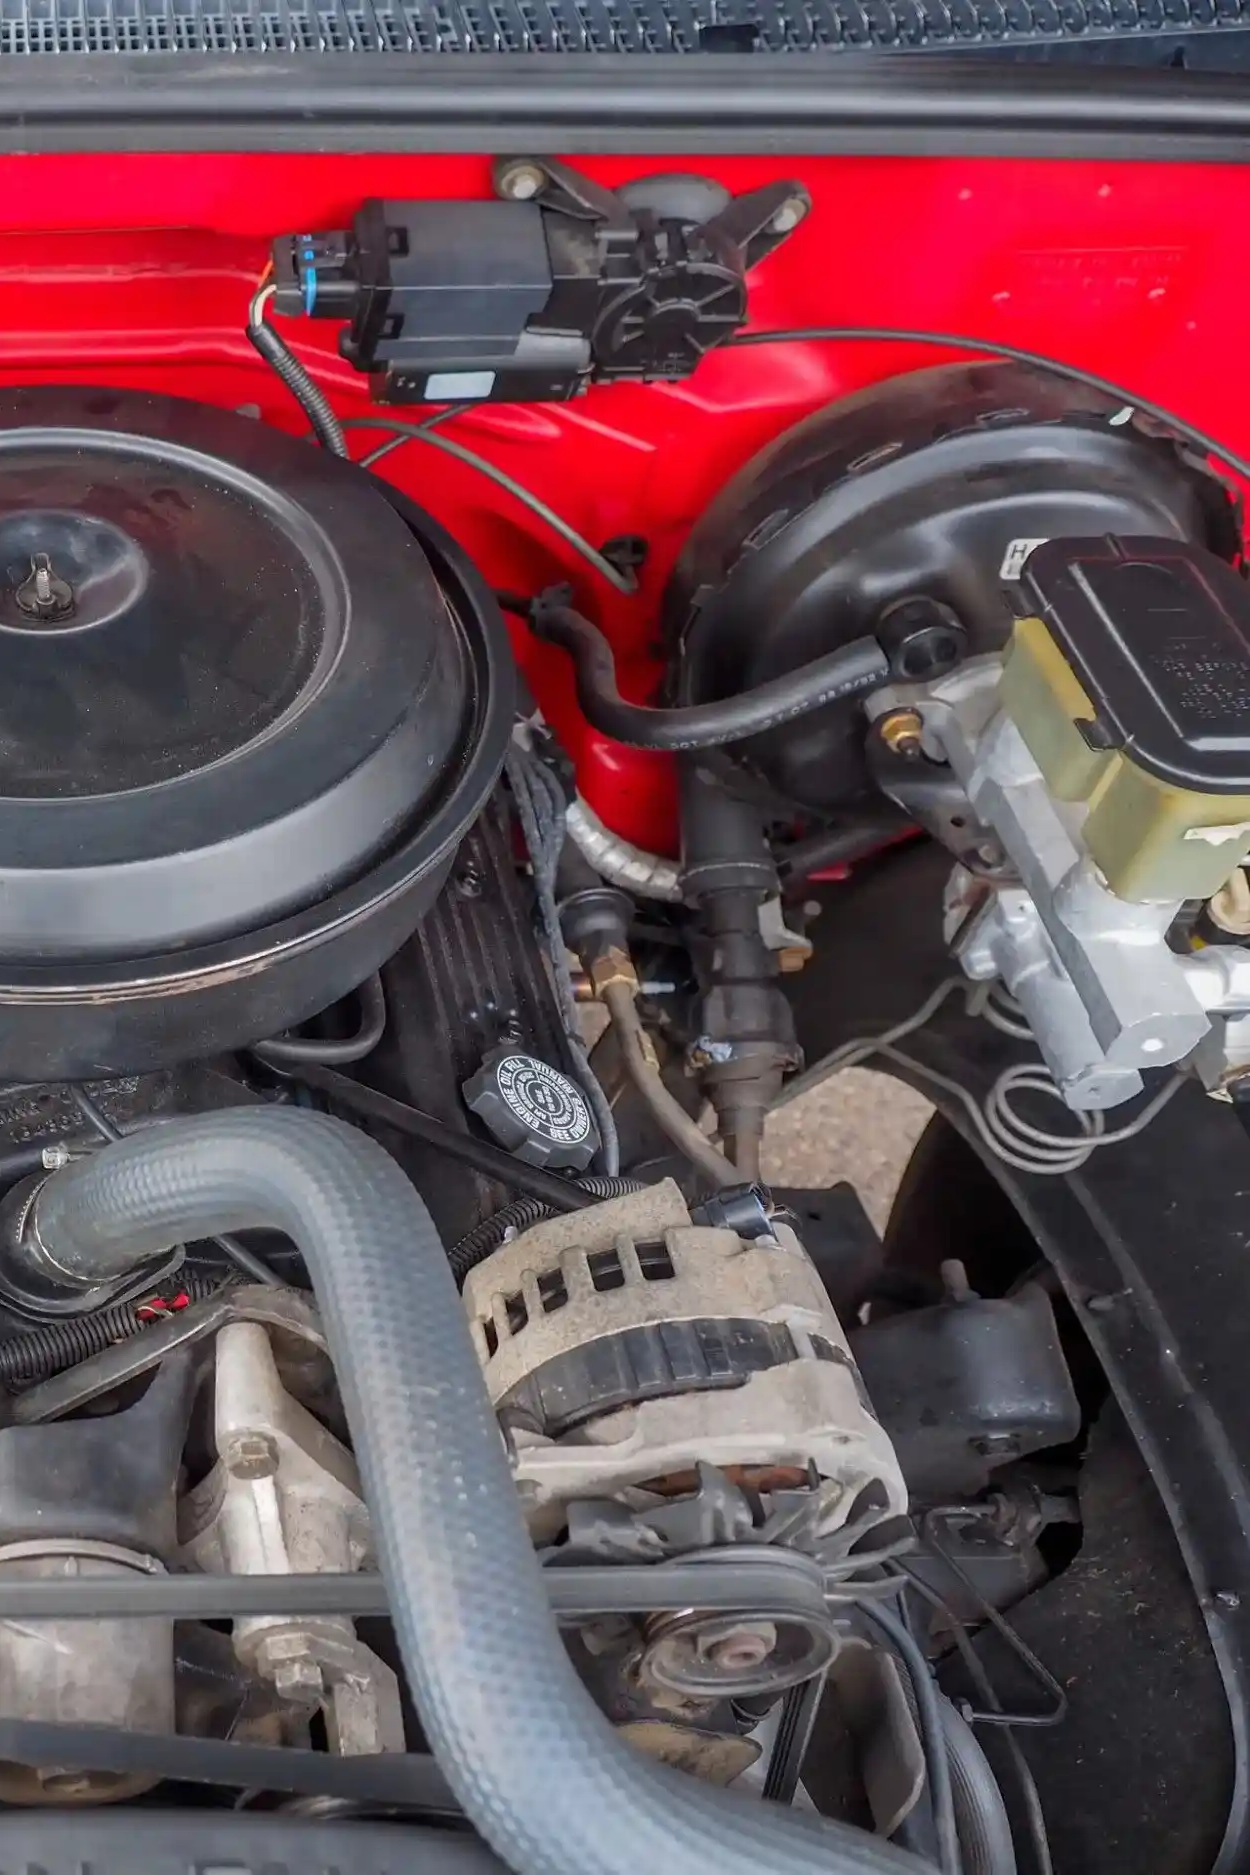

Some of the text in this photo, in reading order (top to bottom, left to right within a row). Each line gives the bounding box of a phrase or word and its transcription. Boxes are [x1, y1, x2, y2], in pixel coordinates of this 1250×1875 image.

[505, 1058, 526, 1075] FILL
[500, 1070, 512, 1086] OIL
[528, 1059, 575, 1094] MANUAL
[503, 1088, 540, 1129] ENGINE
[549, 1127, 571, 1141] SEE
